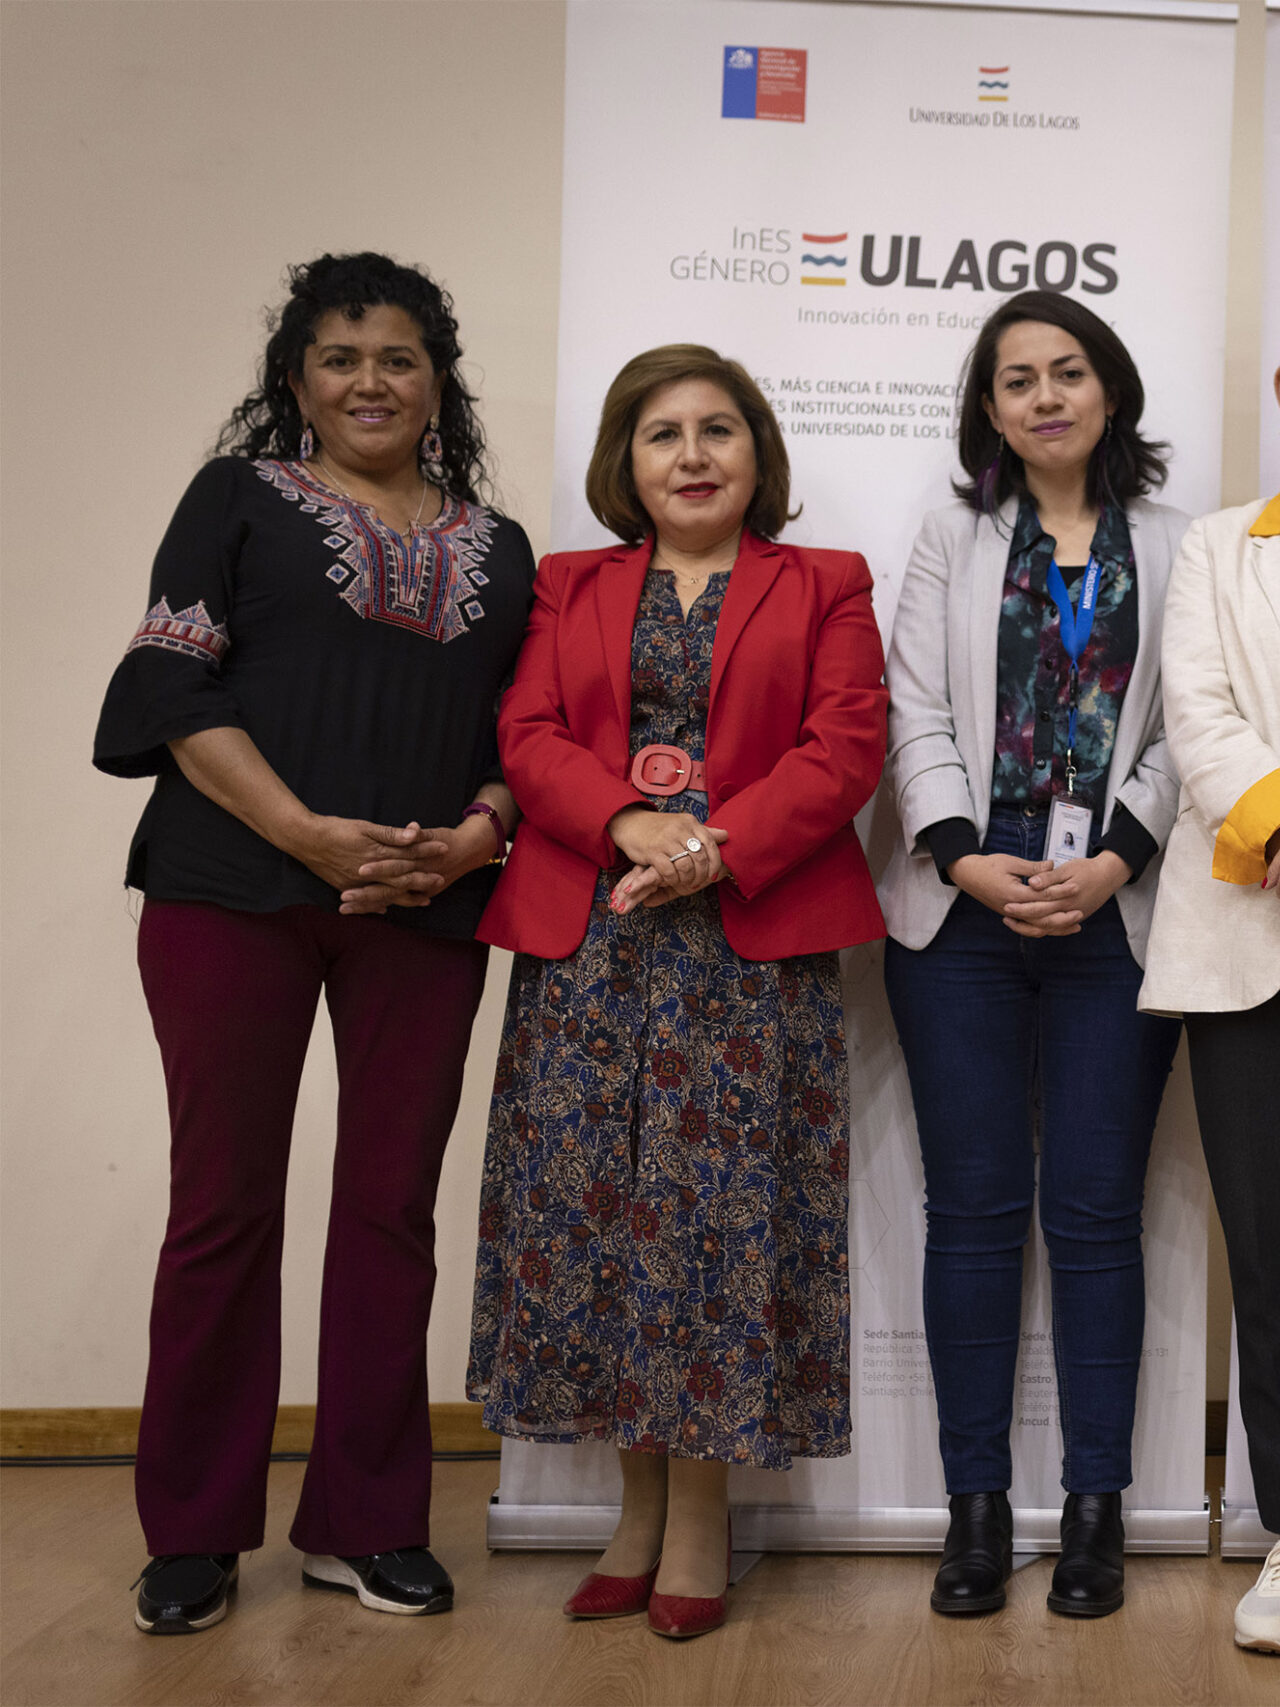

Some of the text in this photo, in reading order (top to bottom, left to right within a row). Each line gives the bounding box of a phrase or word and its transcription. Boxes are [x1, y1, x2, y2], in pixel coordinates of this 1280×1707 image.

[732, 226, 791, 254] InES
[669, 249, 790, 286] GÉNERO
[860, 234, 1119, 295] ULAGOS
[797, 306, 899, 326] Innovación
[906, 311, 929, 326] en
[780, 376, 812, 393] MÁS
[816, 379, 871, 396] CIENCIA
[875, 381, 884, 395] E
[791, 400, 916, 417] INSTITUCIONALES
[920, 404, 950, 418] CON
[791, 421, 885, 437] UNIVERSIDAD
[890, 423, 908, 438] DE
[913, 424, 941, 439] LOS
[863, 1329, 889, 1339] Sede
[1020, 1331, 1046, 1341] Sede
[863, 1343, 913, 1355] República
[863, 1358, 893, 1368] Barrio
[862, 1371, 905, 1382] Teléfono
